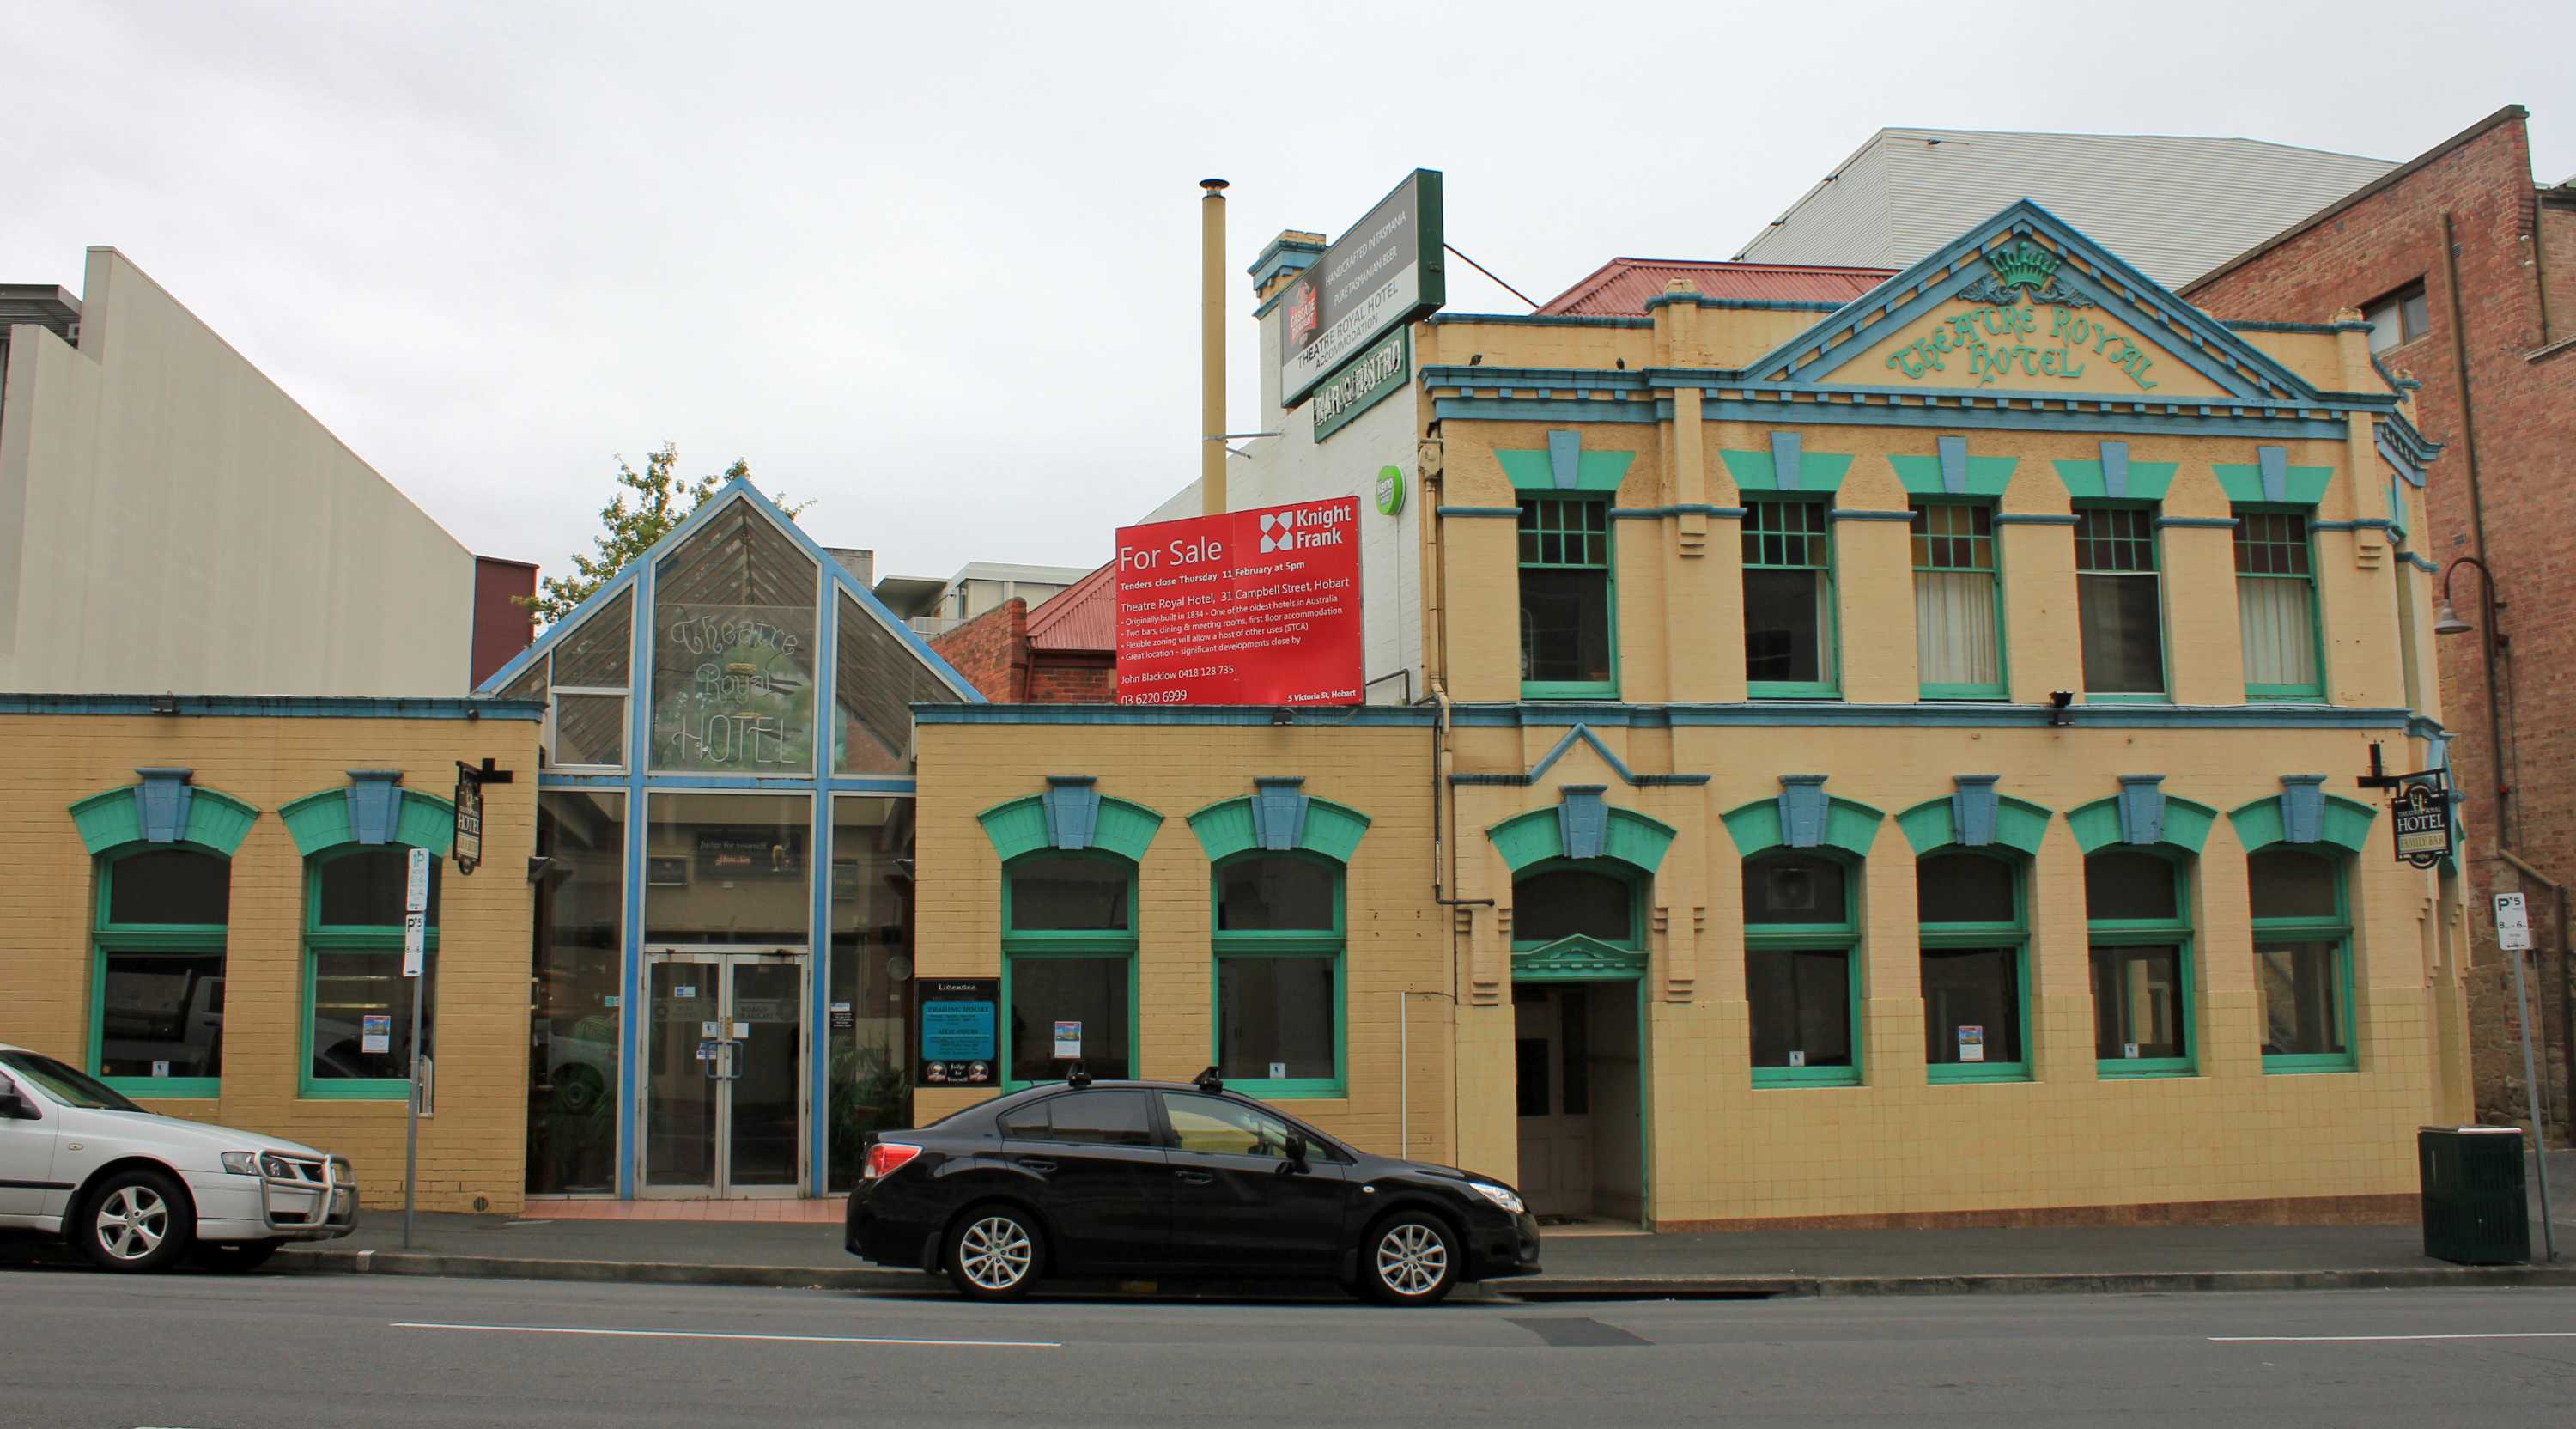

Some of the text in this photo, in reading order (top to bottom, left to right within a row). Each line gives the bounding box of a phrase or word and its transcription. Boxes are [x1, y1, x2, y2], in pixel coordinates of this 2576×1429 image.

[1325, 210, 1406, 289] HANDCRAFTED IN TASMANIA
[1298, 280, 1399, 369] THEATRE ROYAL HOTEL
[1315, 314, 1378, 371] ACCOMMODATION
[2050, 304, 2158, 390] ROYAL
[1297, 504, 1352, 528] Knight
[1297, 527, 1343, 549] Frank
[1120, 535, 1223, 572] For Sale
[1121, 581, 1152, 591] Tenders
[1155, 577, 1176, 587] close
[1180, 573, 1218, 584] Thursday
[1222, 569, 1232, 579] 11
[1235, 566, 1272, 577] February
[1285, 561, 1305, 572] 5pm
[1121, 578, 1350, 612] Theatre Royal Hotel, 31 Campbell Street, Hobart
[1126, 614, 1159, 626] Originally
[1160, 613, 1176, 623] built
[1187, 611, 1204, 619] 1834
[1210, 608, 1226, 617] One
[1227, 605, 1236, 614] of
[1249, 603, 1272, 612] oldest
[1273, 600, 1295, 610] hotels
[1306, 594, 1338, 605] Australia
[671, 615, 799, 656] Theatre
[1159, 625, 1182, 635] dining
[1192, 620, 1222, 630] meeting
[1249, 615, 1264, 623] first
[1265, 613, 1282, 623] floor
[1284, 606, 1343, 620] accommodation
[1126, 640, 1151, 649] Flexible
[1153, 637, 1177, 647] zoning
[1178, 635, 1190, 643] will
[1192, 633, 1211, 642] allow
[1218, 630, 1235, 639] host
[1245, 626, 1265, 635] other
[1267, 625, 1284, 634] uses
[1285, 623, 1309, 633] (STCA)
[1126, 651, 1145, 660] Great
[1145, 648, 1174, 659] location
[1181, 645, 1217, 656] significant
[1218, 639, 1270, 652] developments
[1271, 636, 1290, 645] close
[1291, 635, 1301, 646] by
[696, 662, 772, 704] Royal
[1121, 665, 1234, 684] John Blacklow 0418 128 735
[1121, 689, 1188, 705] 03 6220 6999
[1294, 692, 1320, 701] Victoria
[1331, 690, 1356, 699] Hobart
[671, 714, 797, 763] HOTEL
[458, 812, 481, 835] HOTEL
[2397, 814, 2445, 832] HOTEL
